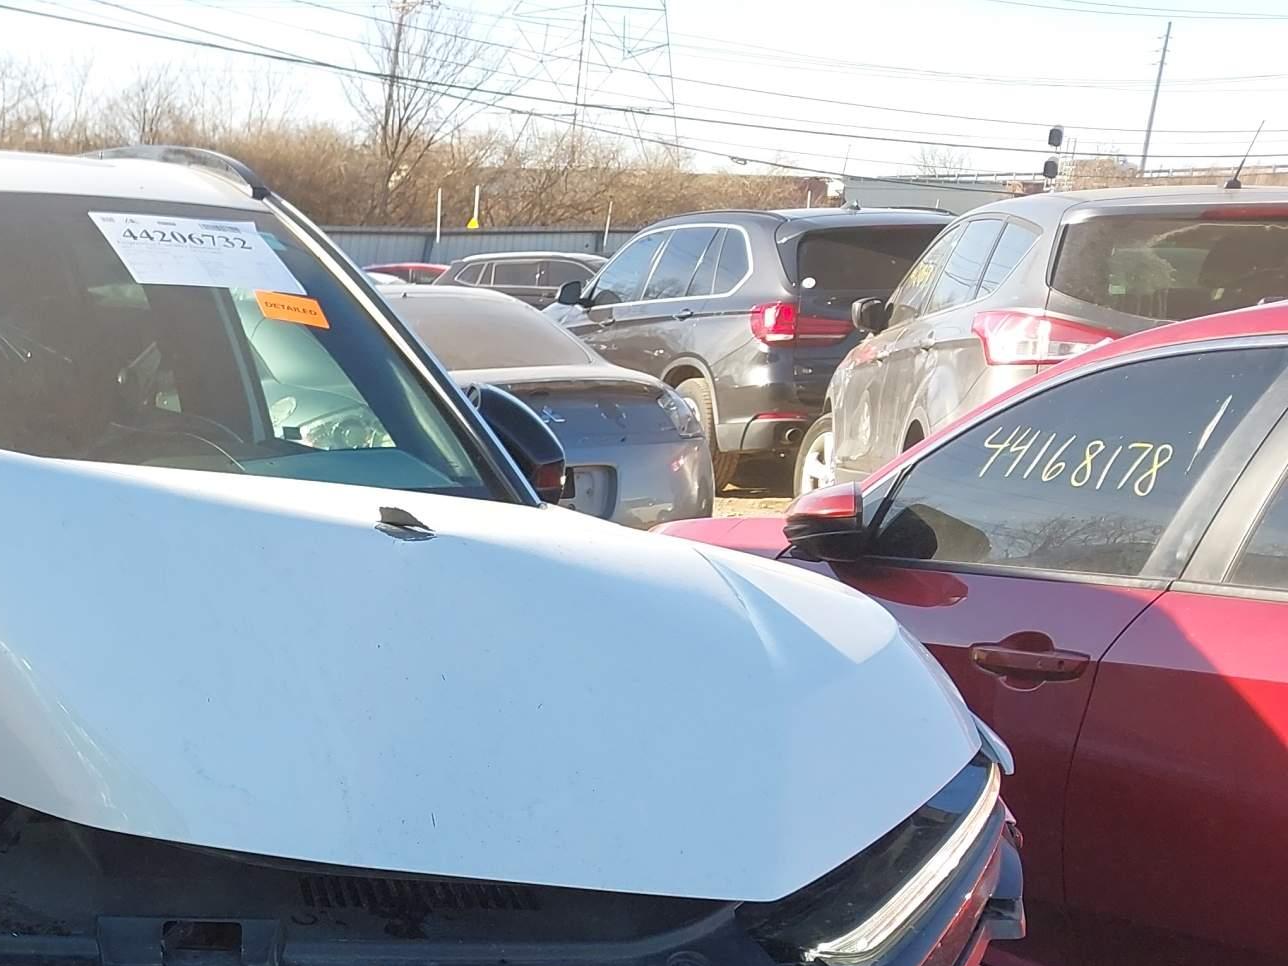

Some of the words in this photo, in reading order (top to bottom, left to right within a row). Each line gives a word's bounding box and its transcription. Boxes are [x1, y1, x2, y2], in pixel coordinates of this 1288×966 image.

[122, 228, 253, 250] 44206732
[264, 301, 317, 316] DETAILED
[978, 425, 1174, 497] 44168178
